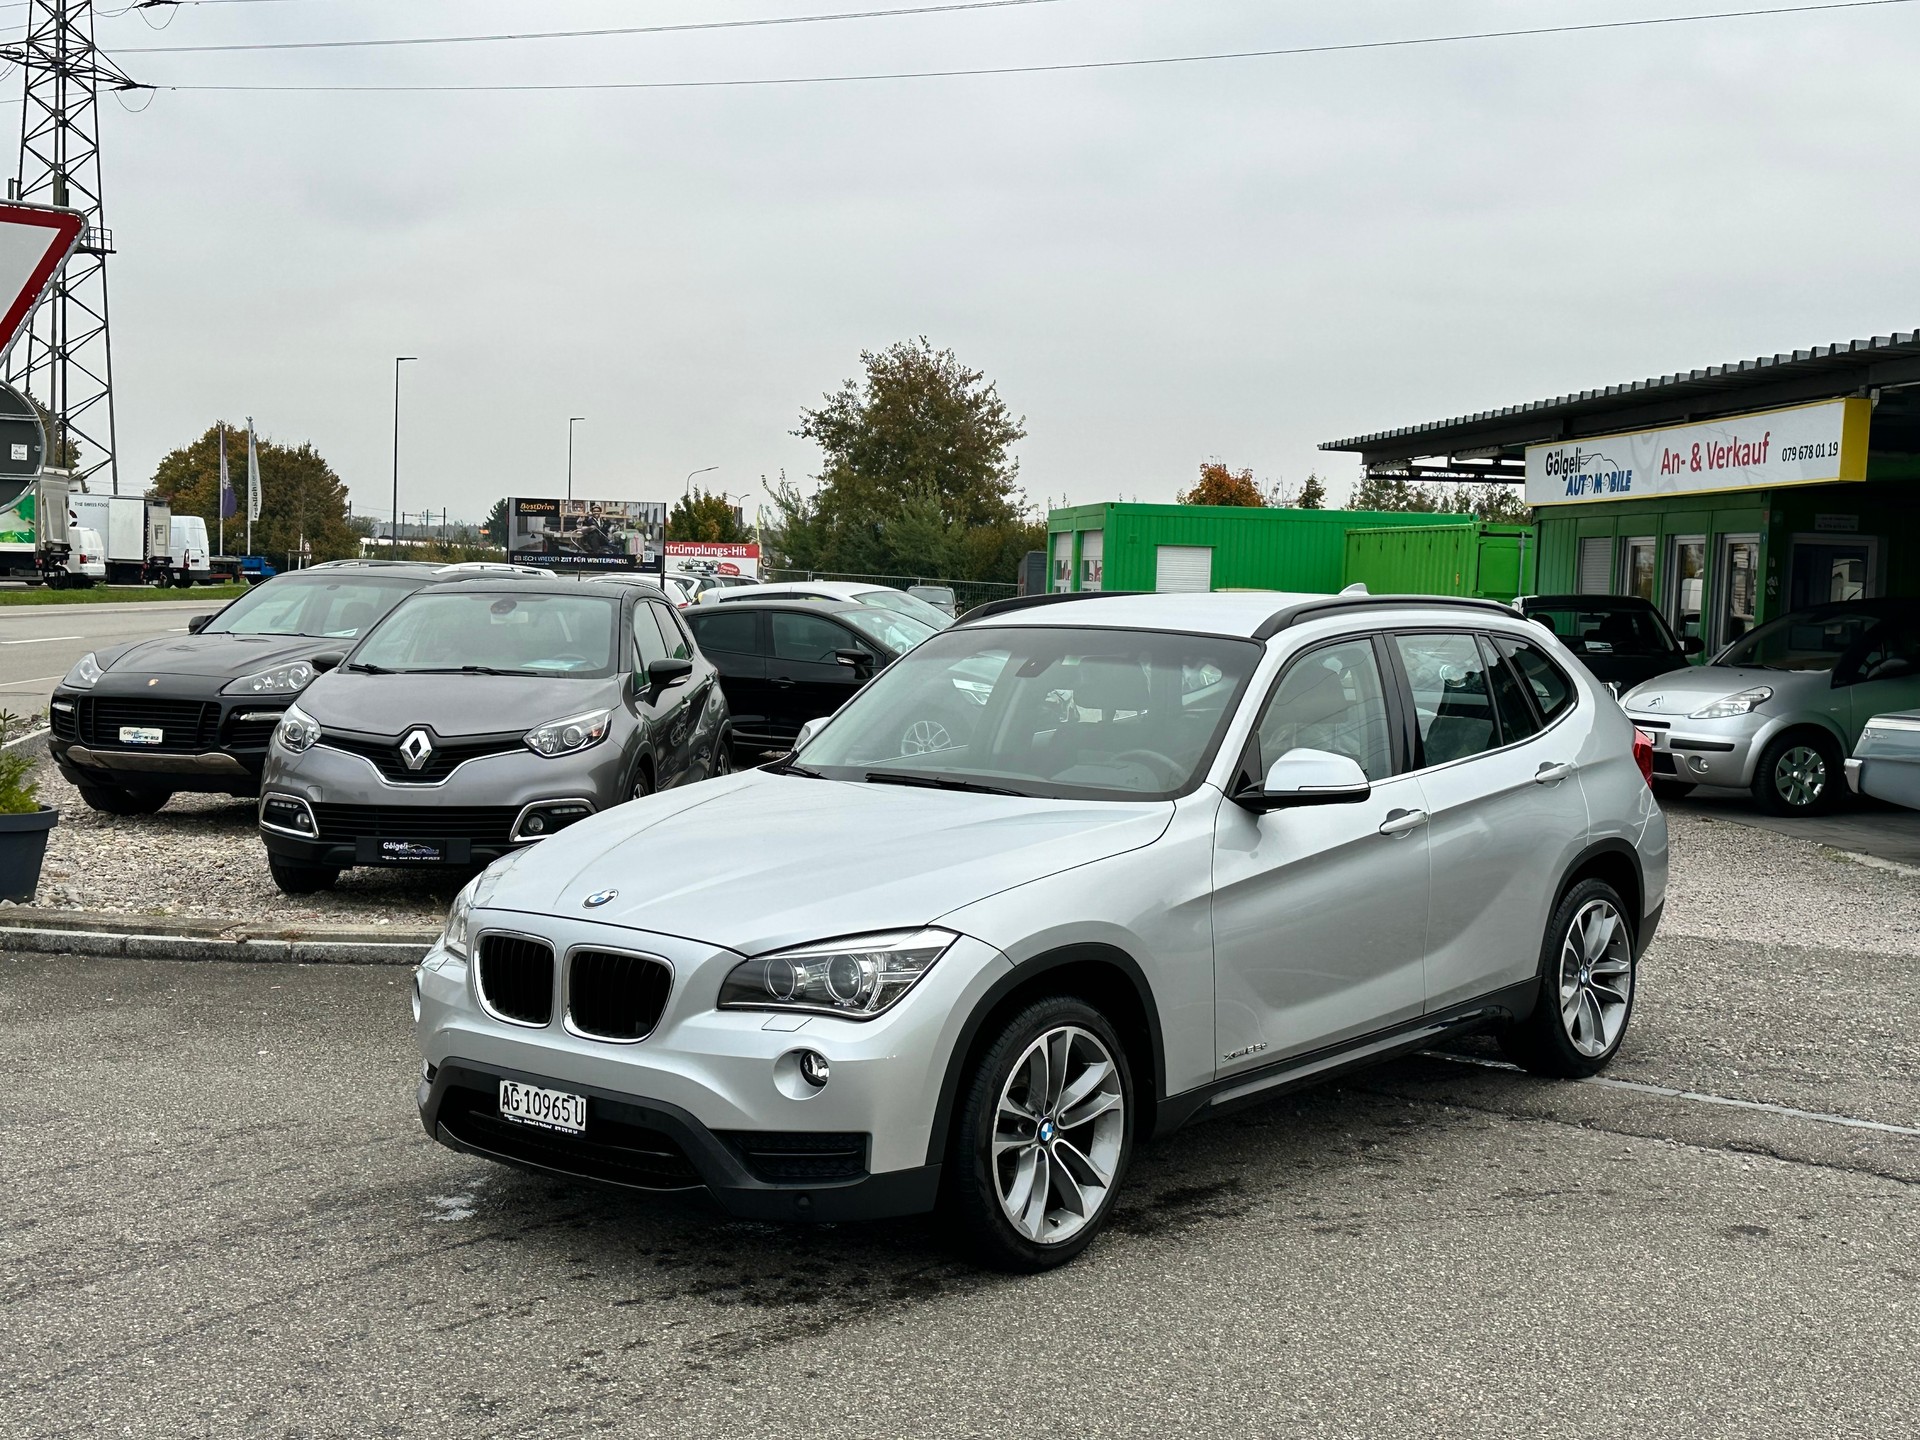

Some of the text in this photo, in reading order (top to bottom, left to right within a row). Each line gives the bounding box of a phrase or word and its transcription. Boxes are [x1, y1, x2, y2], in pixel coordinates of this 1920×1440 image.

[1546, 447, 1582, 481] Gölgeli
[1660, 431, 1771, 475] An- & Verkauf
[1781, 441, 1839, 462] 079 678 01 19
